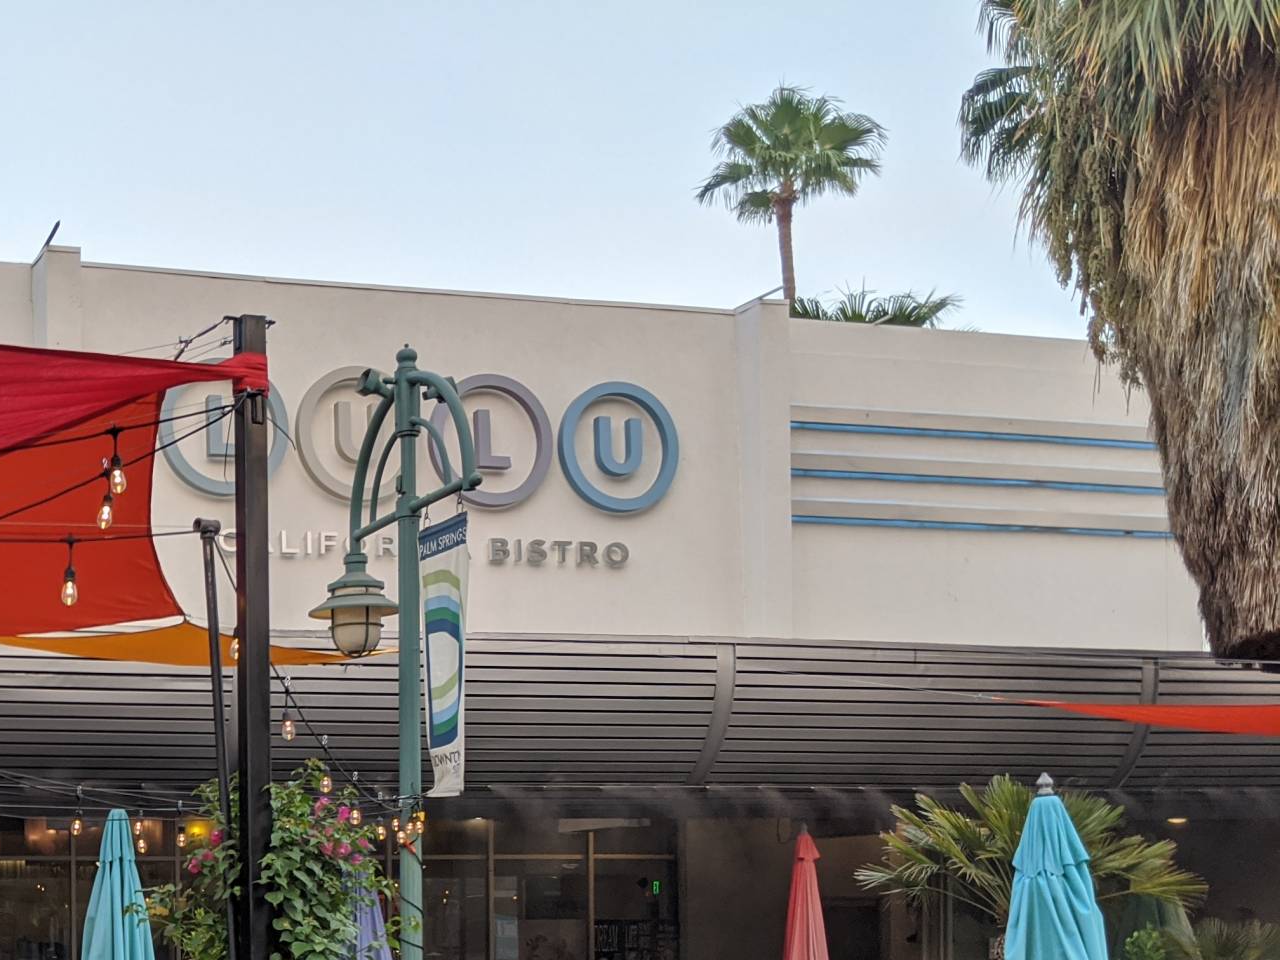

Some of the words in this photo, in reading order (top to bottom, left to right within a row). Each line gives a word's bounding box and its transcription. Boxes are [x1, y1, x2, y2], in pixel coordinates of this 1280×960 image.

[419, 540, 437, 557] PALM
[438, 527, 466, 550] SPRINGS
[489, 537, 631, 568] BISTRO
